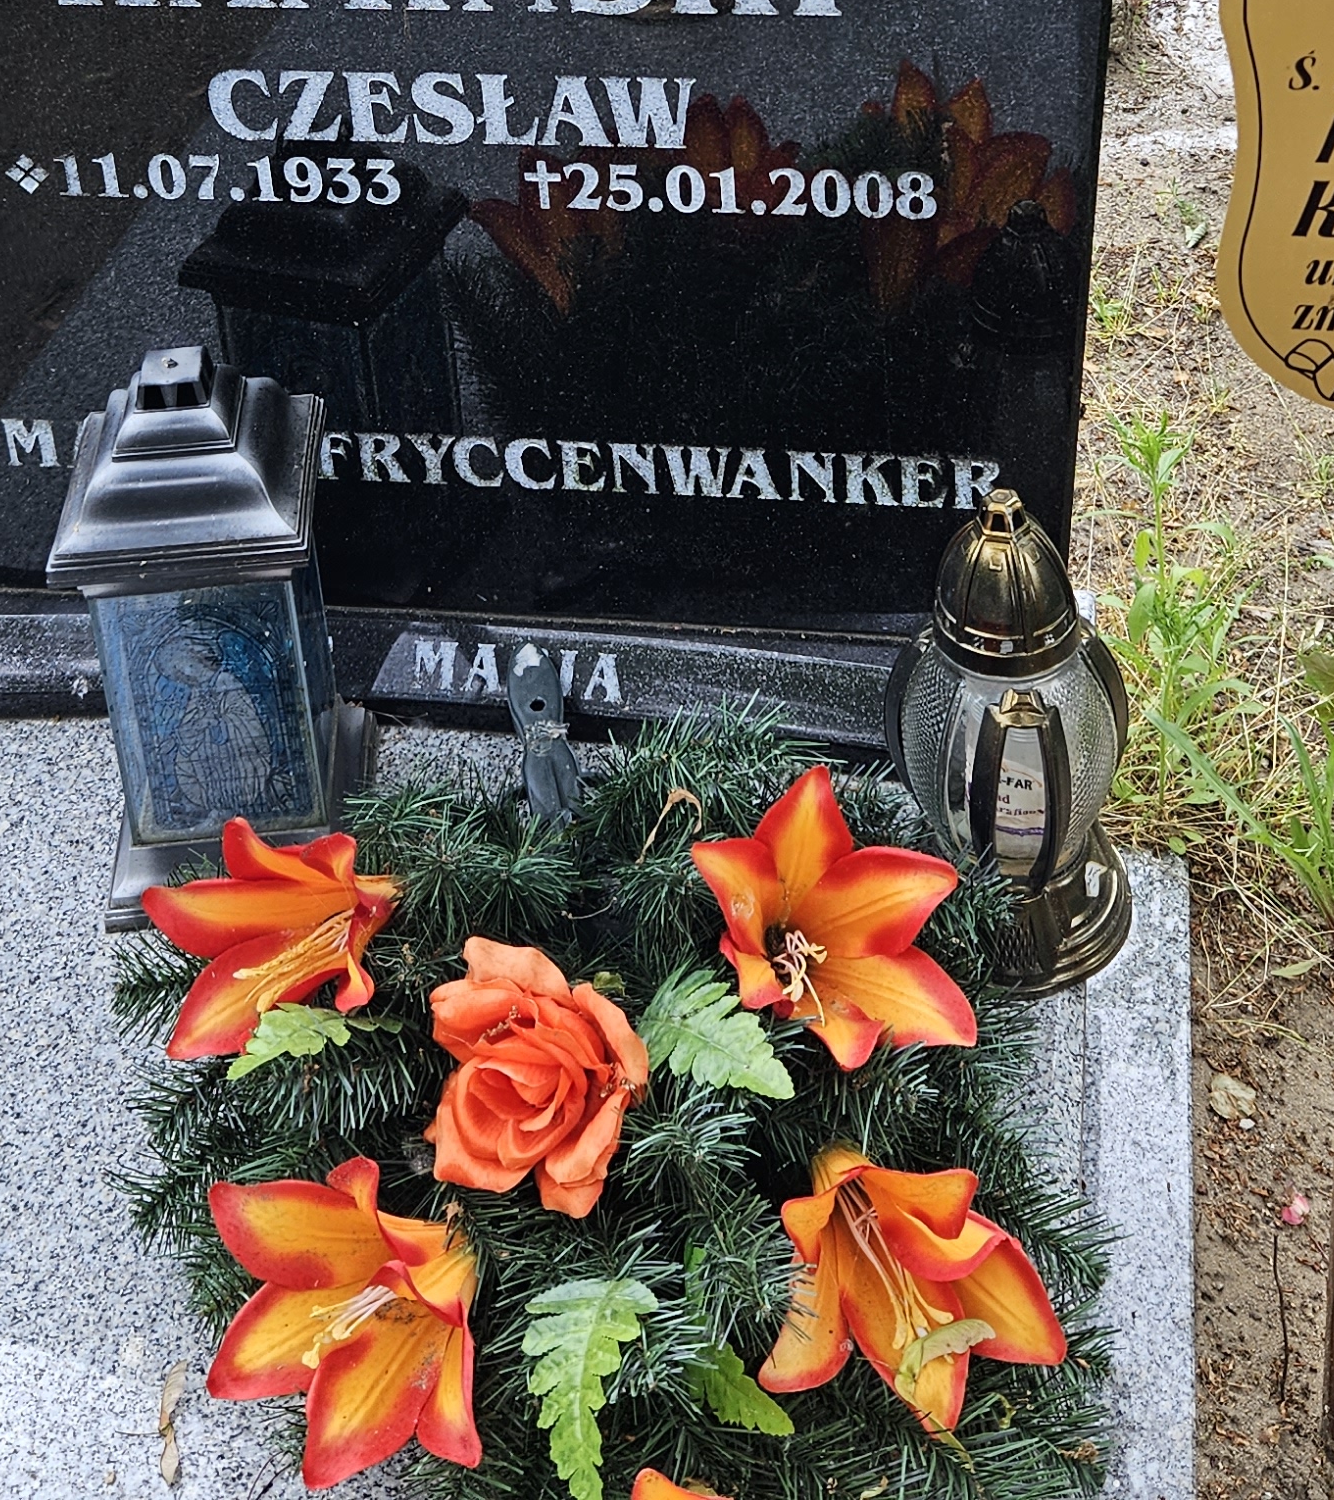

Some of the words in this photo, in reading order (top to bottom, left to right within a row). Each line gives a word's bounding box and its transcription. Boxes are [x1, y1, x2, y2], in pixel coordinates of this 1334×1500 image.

[207, 69, 697, 149] CZESŁAW
[53, 152, 402, 206] 11.07.1933
[413, 640, 625, 705] MAIA
